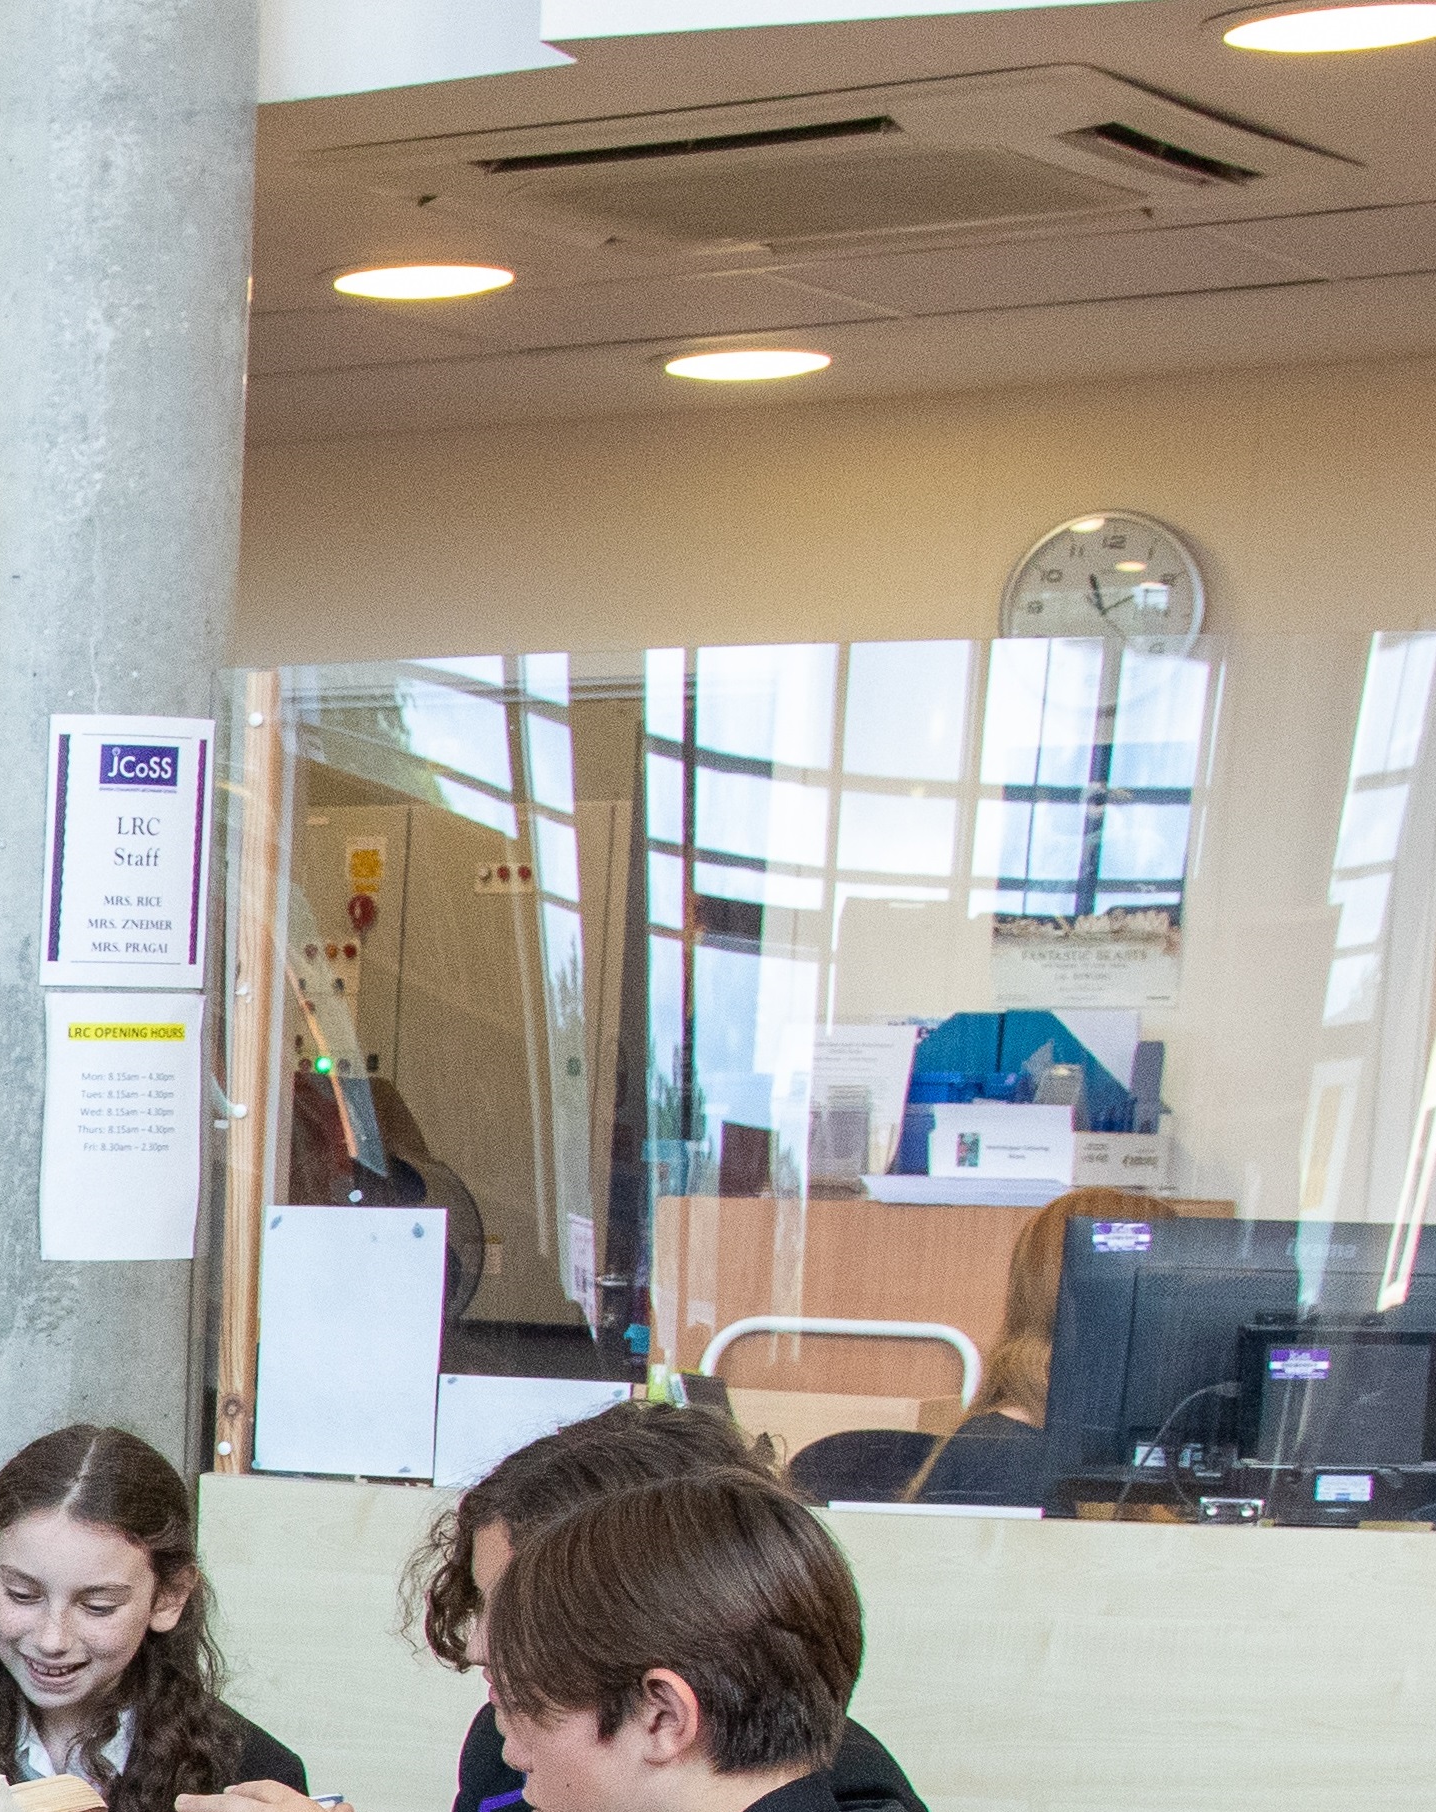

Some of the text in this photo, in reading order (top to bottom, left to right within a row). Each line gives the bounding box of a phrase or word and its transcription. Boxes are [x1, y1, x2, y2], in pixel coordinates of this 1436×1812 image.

[117, 816, 161, 836] LRC
[113, 848, 161, 867] Staff
[103, 895, 163, 907] MRS. RICE
[87, 918, 173, 930] MRS. ZNEIMER
[91, 942, 169, 953] MRS. PRAGAI
[68, 1027, 148, 1039] LRC OPENING
